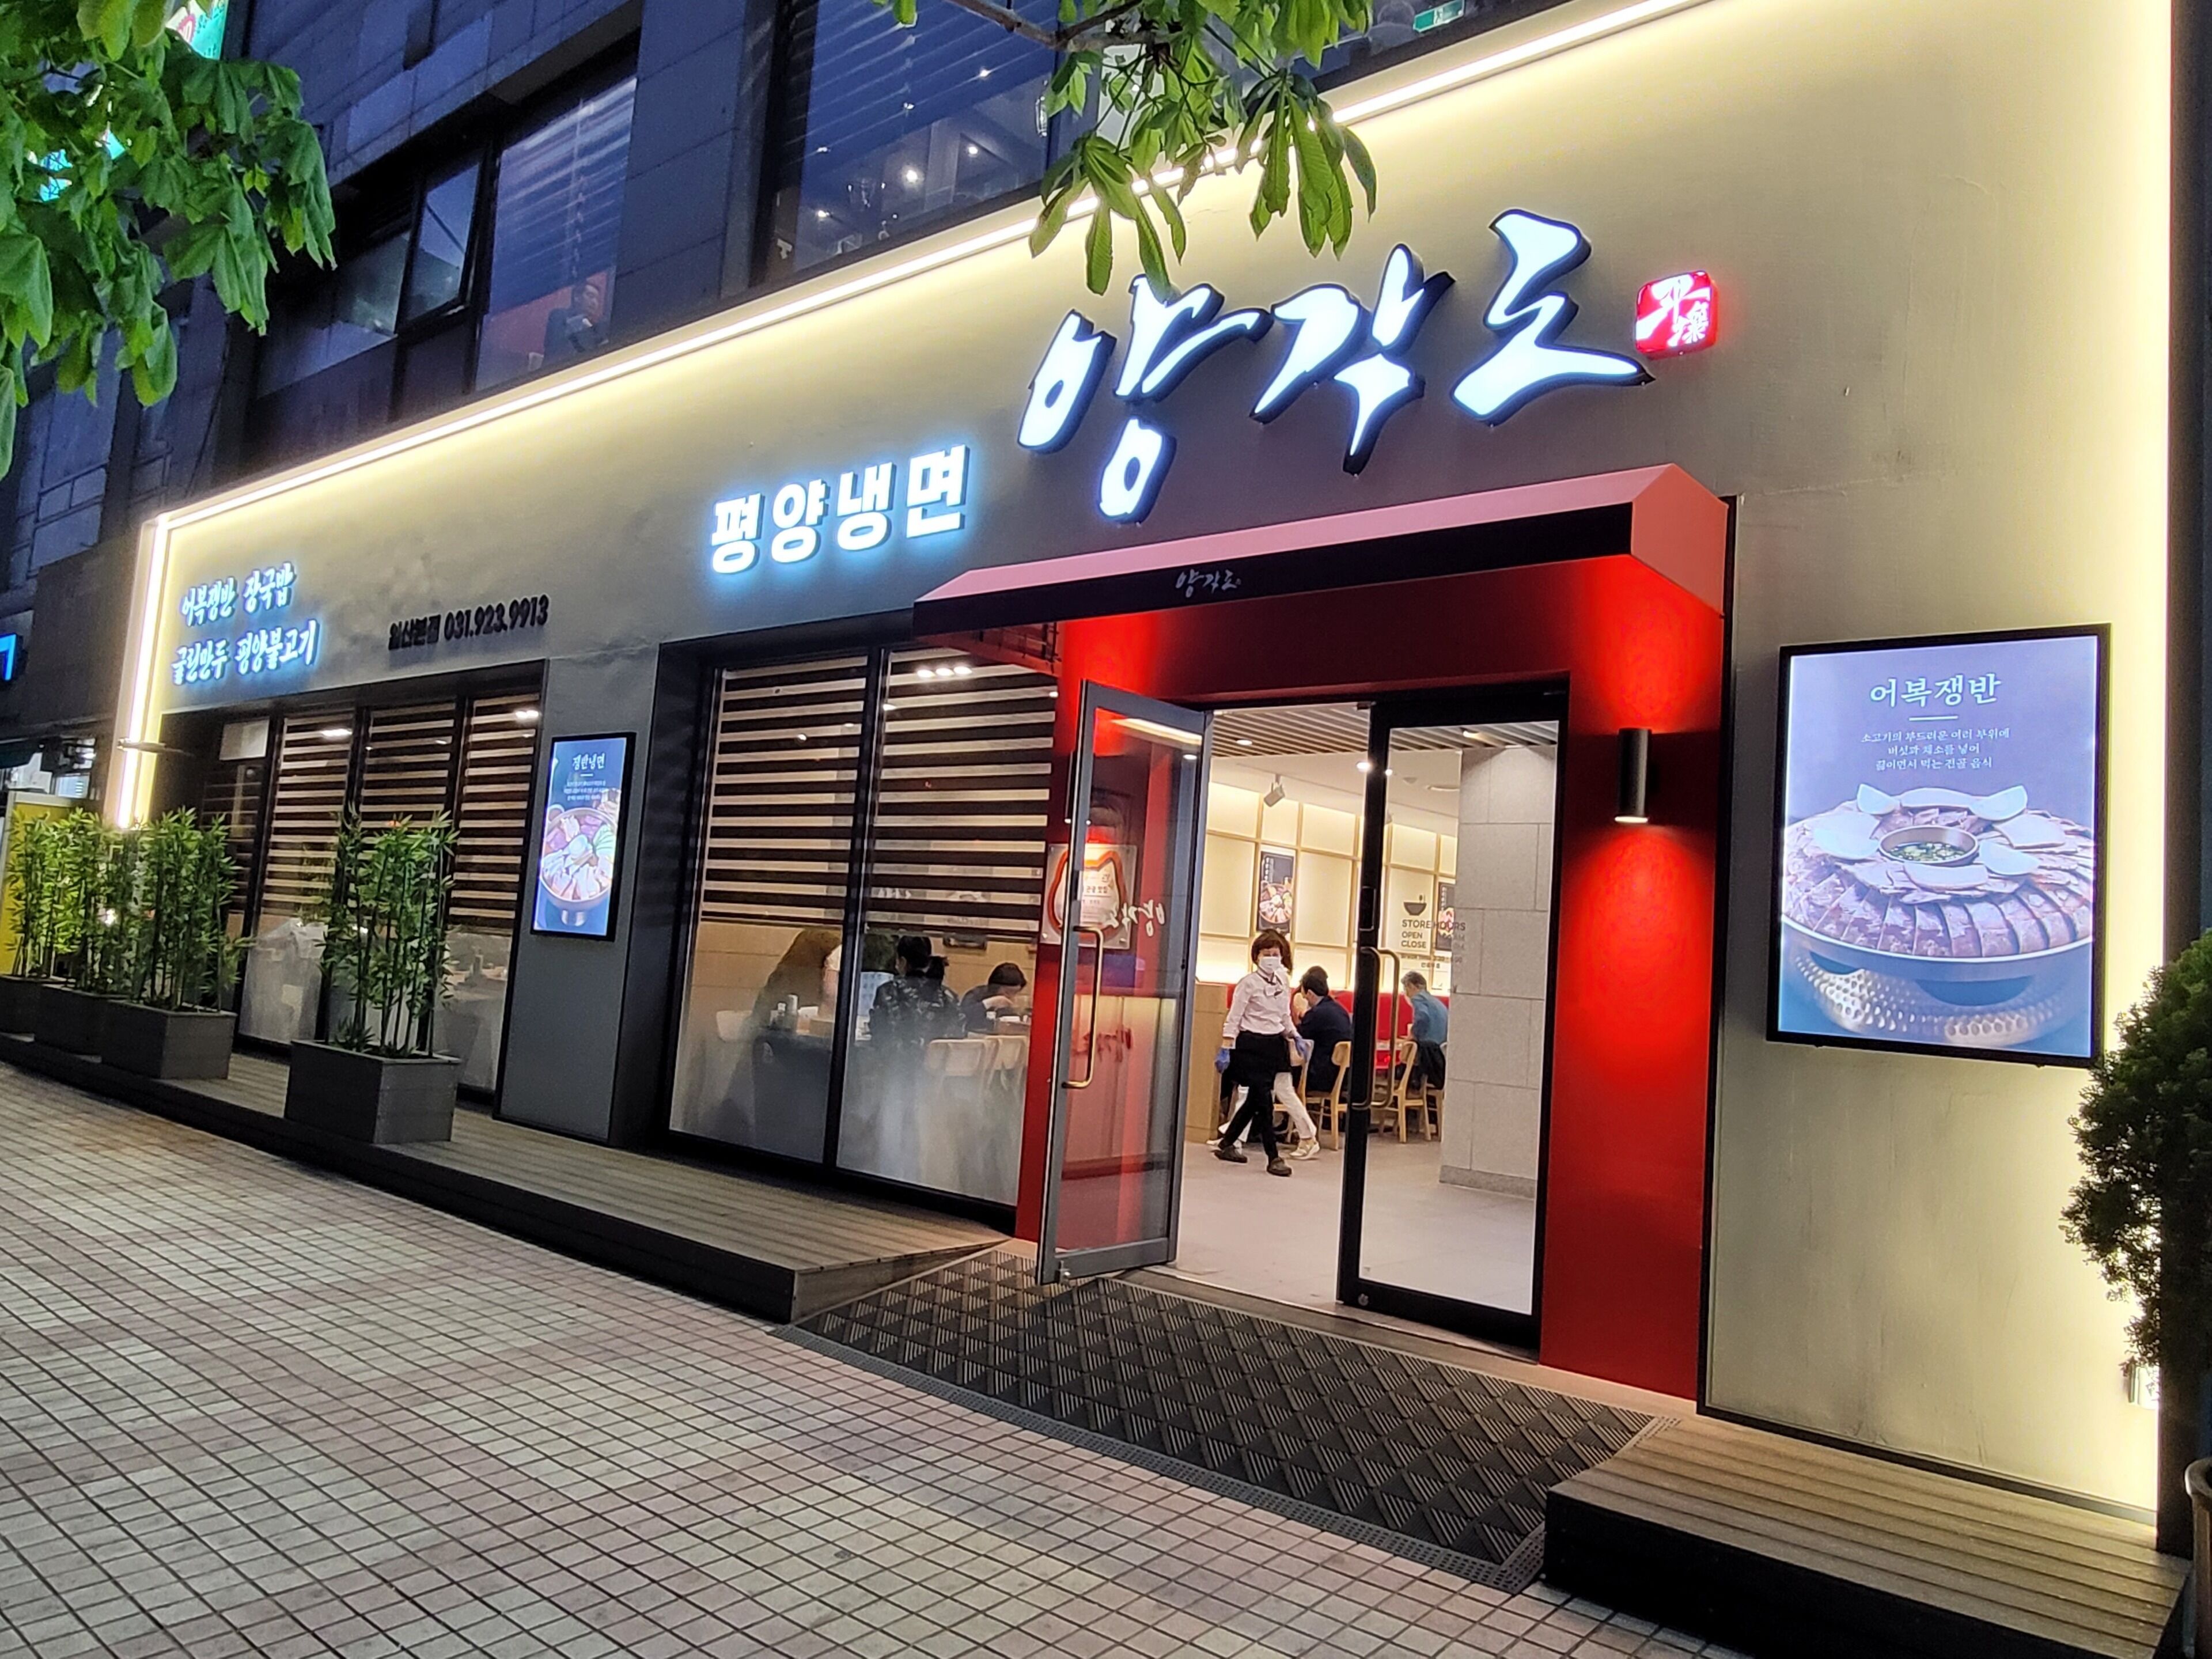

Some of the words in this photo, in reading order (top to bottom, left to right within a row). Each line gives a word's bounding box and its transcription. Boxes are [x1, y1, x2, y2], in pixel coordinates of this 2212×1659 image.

[1017, 209, 1654, 523] 양각도
[711, 445, 969, 574] 평양냉면
[181, 576, 238, 627] 어복쟁반
[243, 561, 296, 613] 장국밥
[1176, 569, 1238, 598] 양각도
[444, 594, 550, 641] 031.923.9913
[171, 638, 230, 685] 굴린만두
[234, 618, 319, 675] 평양불고기
[1870, 672, 2002, 708] 어복쟁반
[1861, 730, 1902, 743] 소고기의
[1905, 729, 1948, 742] 부드러운
[1970, 756, 1993, 768] 음식
[1402, 919, 1431, 929] STORE
[1402, 931, 1423, 939] OPEN
[1401, 940, 1426, 949] CLOSE
